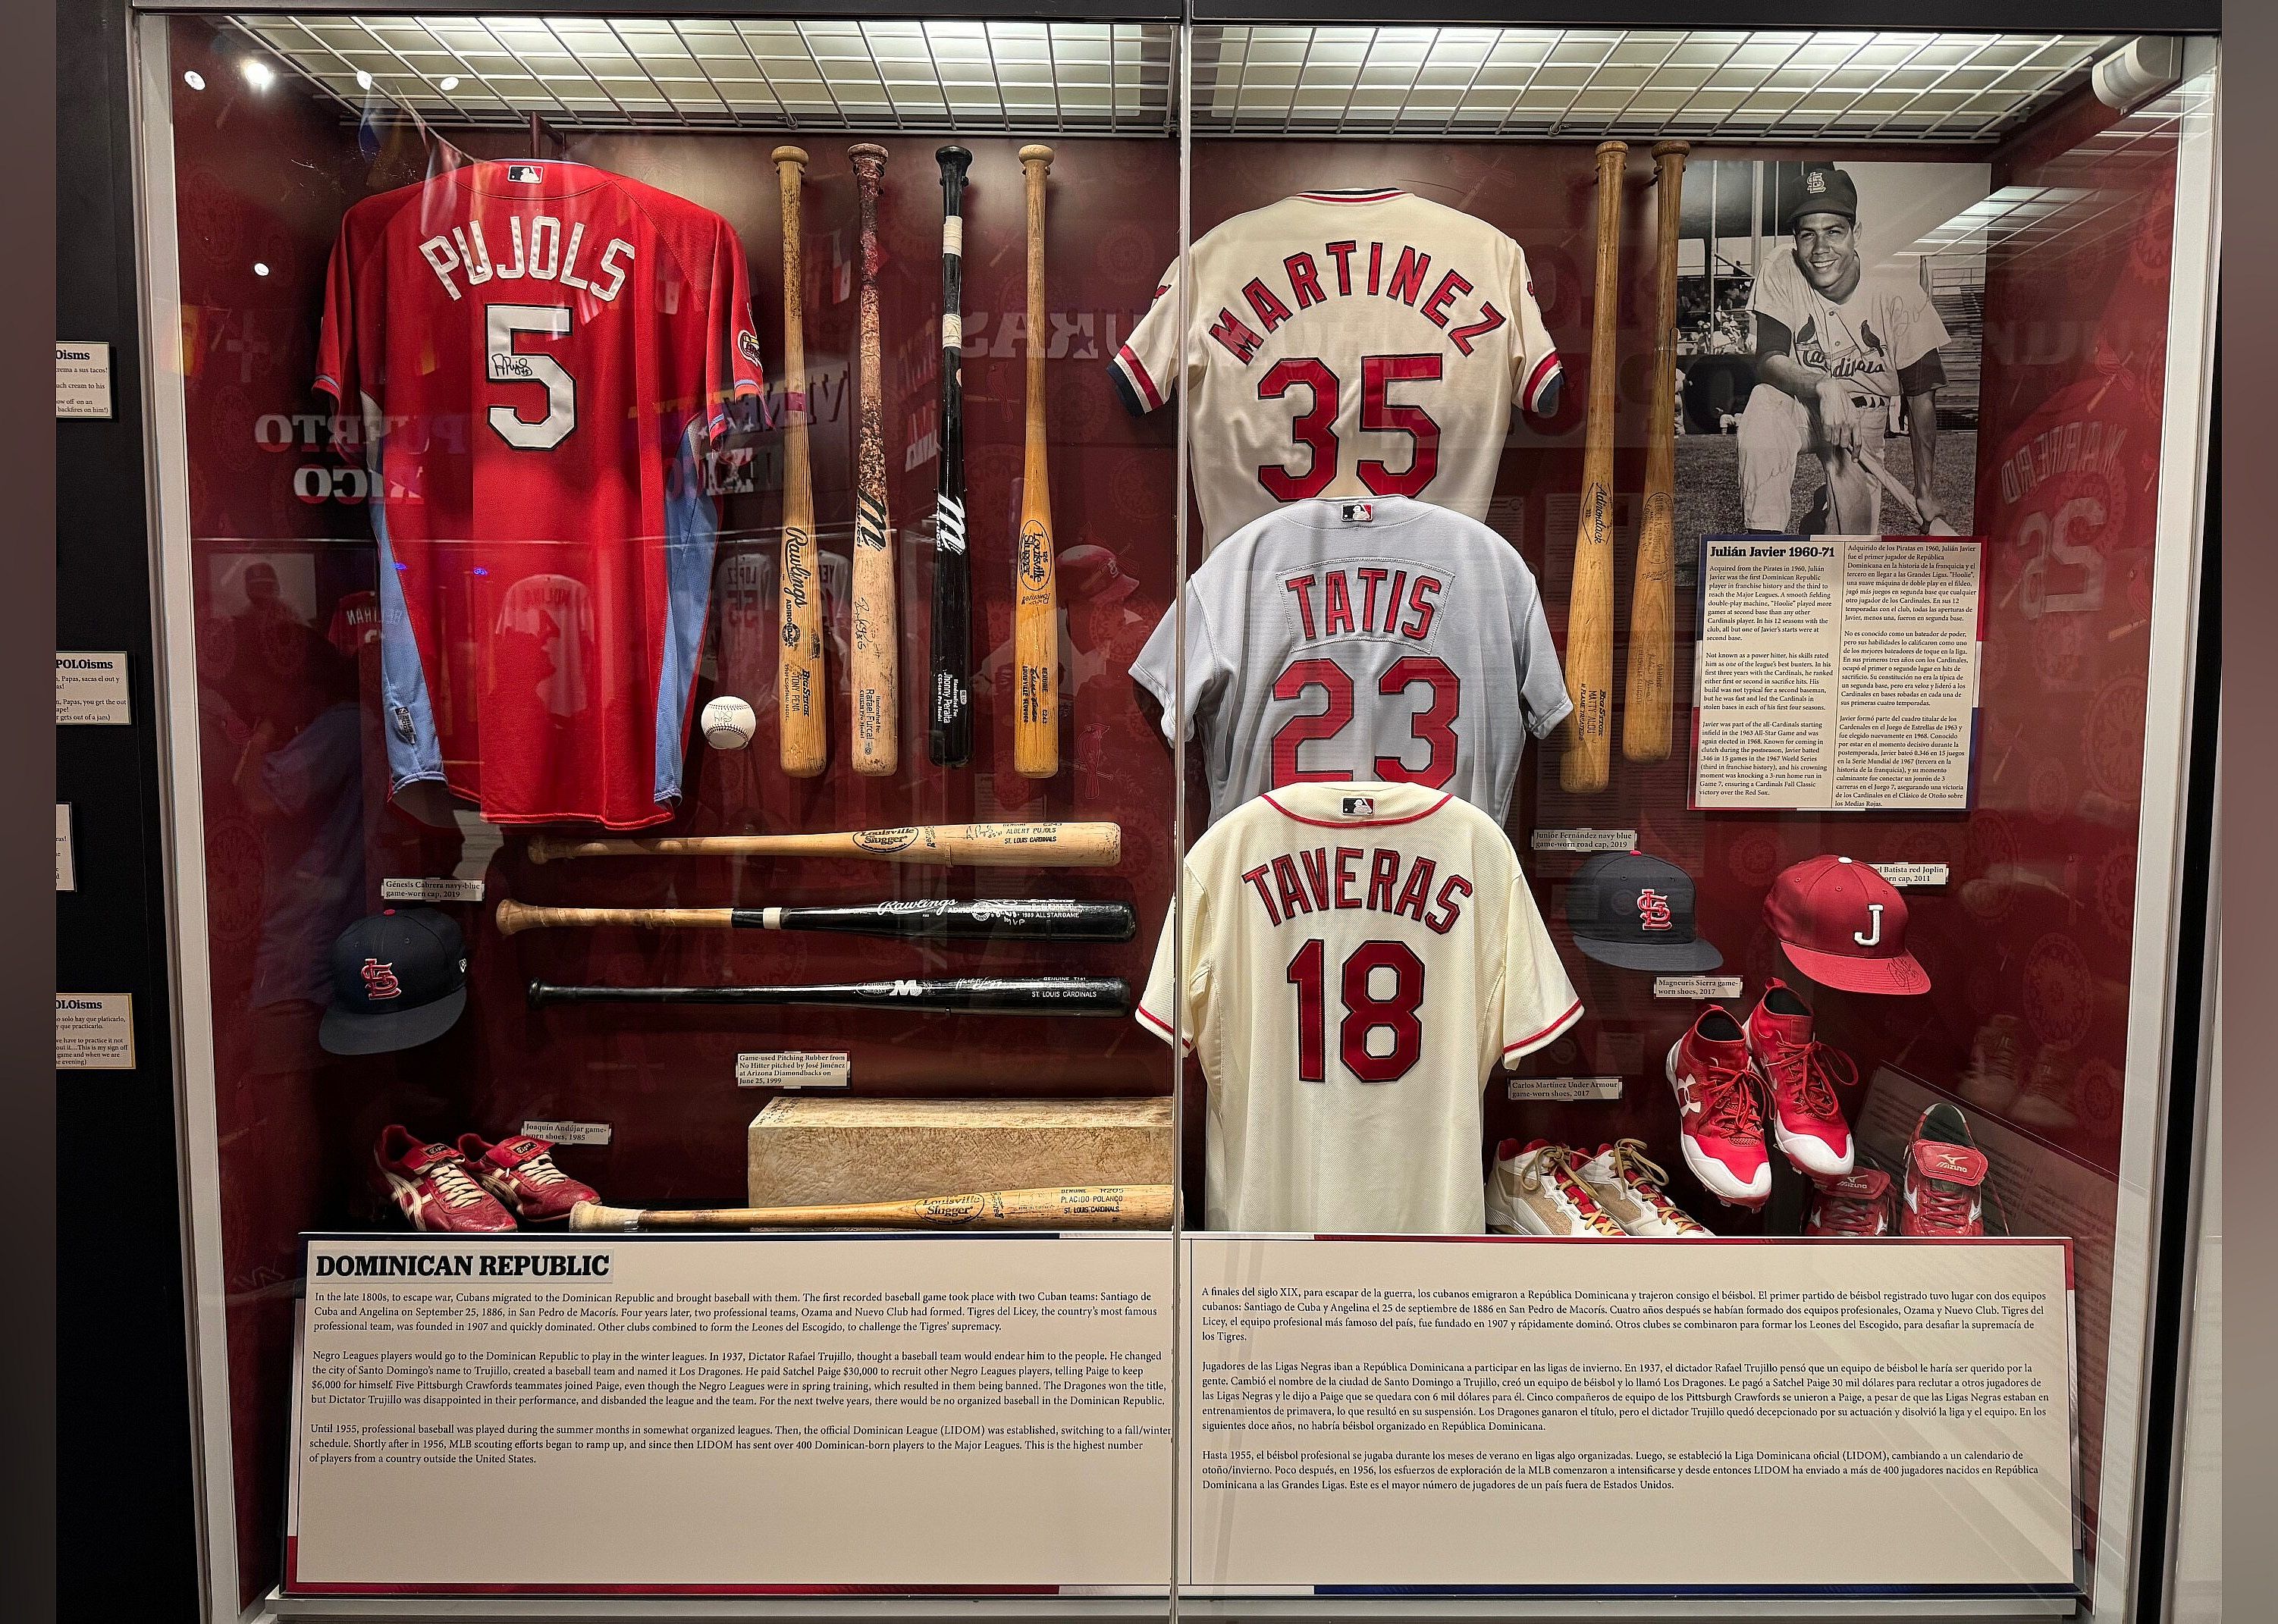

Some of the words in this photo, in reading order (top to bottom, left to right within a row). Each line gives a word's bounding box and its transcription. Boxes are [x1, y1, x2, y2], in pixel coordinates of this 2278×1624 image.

[419, 215, 635, 301] PUJOLS
[1209, 240, 1506, 366] MARTINEZ
[484, 304, 578, 450] 5
[1258, 353, 1442, 503] 35
[1593, 483, 1608, 545] Adirondack
[1021, 535, 1034, 577] Slugger
[1033, 531, 1045, 583] Louisville
[1709, 546, 1746, 557] Julián
[1749, 547, 1786, 557] Javier
[1789, 547, 1835, 557] 1960-71
[784, 527, 811, 608] Rawlings
[1287, 568, 1442, 641] TATIS
[786, 599, 795, 648] ADIRONDACK
[791, 676, 800, 691] TONY
[942, 672, 952, 697] Jhonny
[865, 688, 875, 714] Rafael
[943, 699, 952, 723] Peralta
[1587, 690, 1597, 713] MATTY
[865, 716, 875, 739] Furcal
[1270, 656, 1461, 788] 23
[1586, 716, 1596, 734] ALOU
[864, 835, 904, 845] Slugger
[1241, 846, 1473, 934] TAVERAS
[877, 898, 958, 916] Rawlings
[1854, 904, 1883, 947] J
[1287, 939, 1426, 1083] 18
[526, 1124, 554, 1133] Joaquín
[554, 1124, 584, 1133] Andújar
[923, 1196, 983, 1206] Louisville
[927, 1205, 972, 1217] Slugger
[316, 1256, 473, 1277] DOMINICAN
[479, 1255, 609, 1276] REPUBLIC
[1202, 1331, 1214, 1340] los
[1217, 1332, 1247, 1343] Tigres.
[1202, 1422, 1245, 1432] siguientes
[1248, 1421, 1269, 1430] doce
[1272, 1422, 1294, 1431] años,
[1312, 1421, 1339, 1430] habría
[1342, 1421, 1374, 1430] béisbol
[1376, 1422, 1426, 1432] organizado
[1442, 1422, 1486, 1432] República
[1489, 1422, 1545, 1431] Dominicana.
[309, 1454, 320, 1463] of
[320, 1454, 352, 1466] players
[354, 1453, 375, 1463] from
[386, 1456, 422, 1466] country
[423, 1454, 457, 1463] outside
[459, 1454, 473, 1463] the
[476, 1454, 505, 1463] United
[508, 1454, 536, 1464] States.
